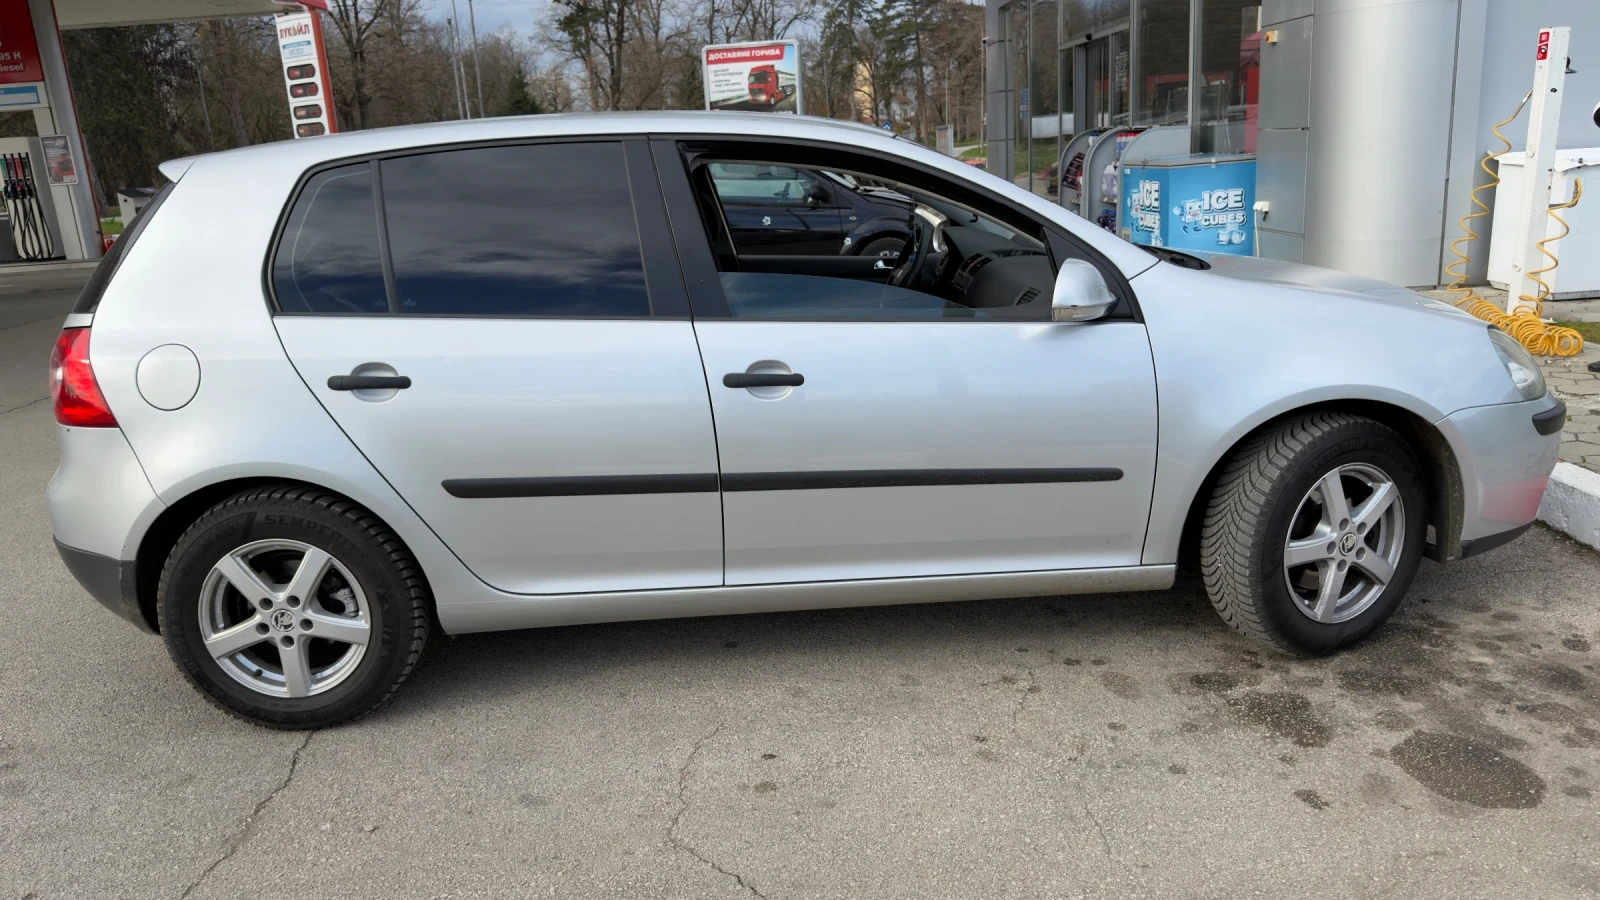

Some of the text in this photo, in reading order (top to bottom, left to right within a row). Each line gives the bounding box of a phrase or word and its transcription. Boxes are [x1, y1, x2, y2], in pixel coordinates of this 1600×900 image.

[709, 48, 780, 61] ДОСТАВЯМЕ ГОРИВА
[0, 63, 24, 72] iesel
[1140, 181, 1159, 211] ICE
[1202, 188, 1245, 212] ICE
[1201, 211, 1246, 229] CUBES
